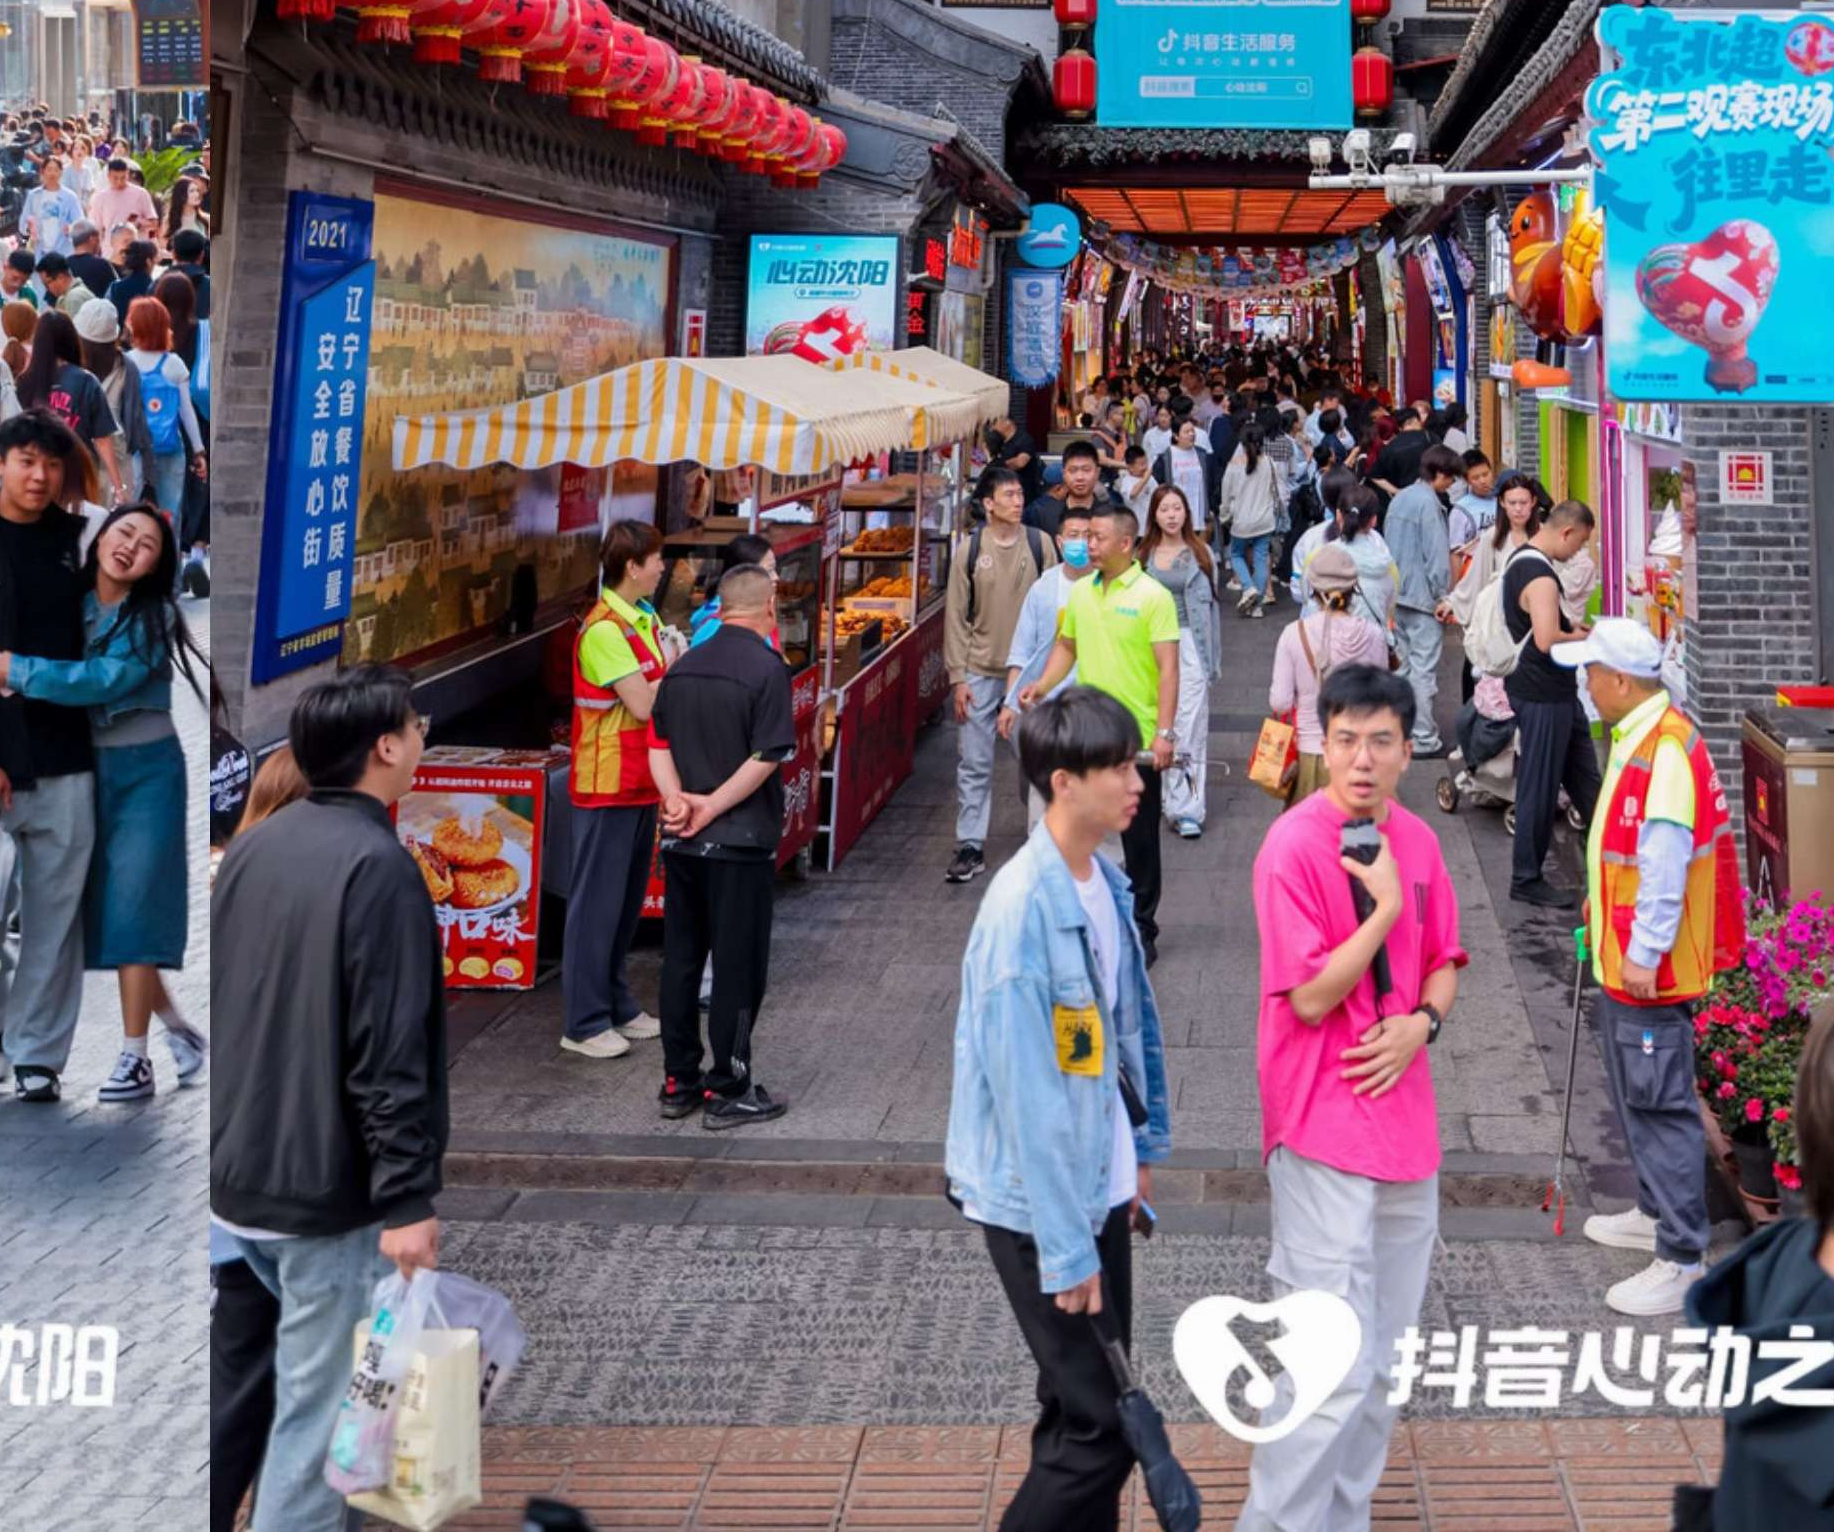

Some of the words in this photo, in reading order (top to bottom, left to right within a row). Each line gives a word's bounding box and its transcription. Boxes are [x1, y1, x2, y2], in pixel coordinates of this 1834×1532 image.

[1622, 16, 1787, 86] 东北超
[1667, 145, 1833, 235] 往里走
[307, 219, 351, 250] 2021
[767, 259, 889, 287] 心动沈阳
[301, 332, 338, 570] 安全放心街
